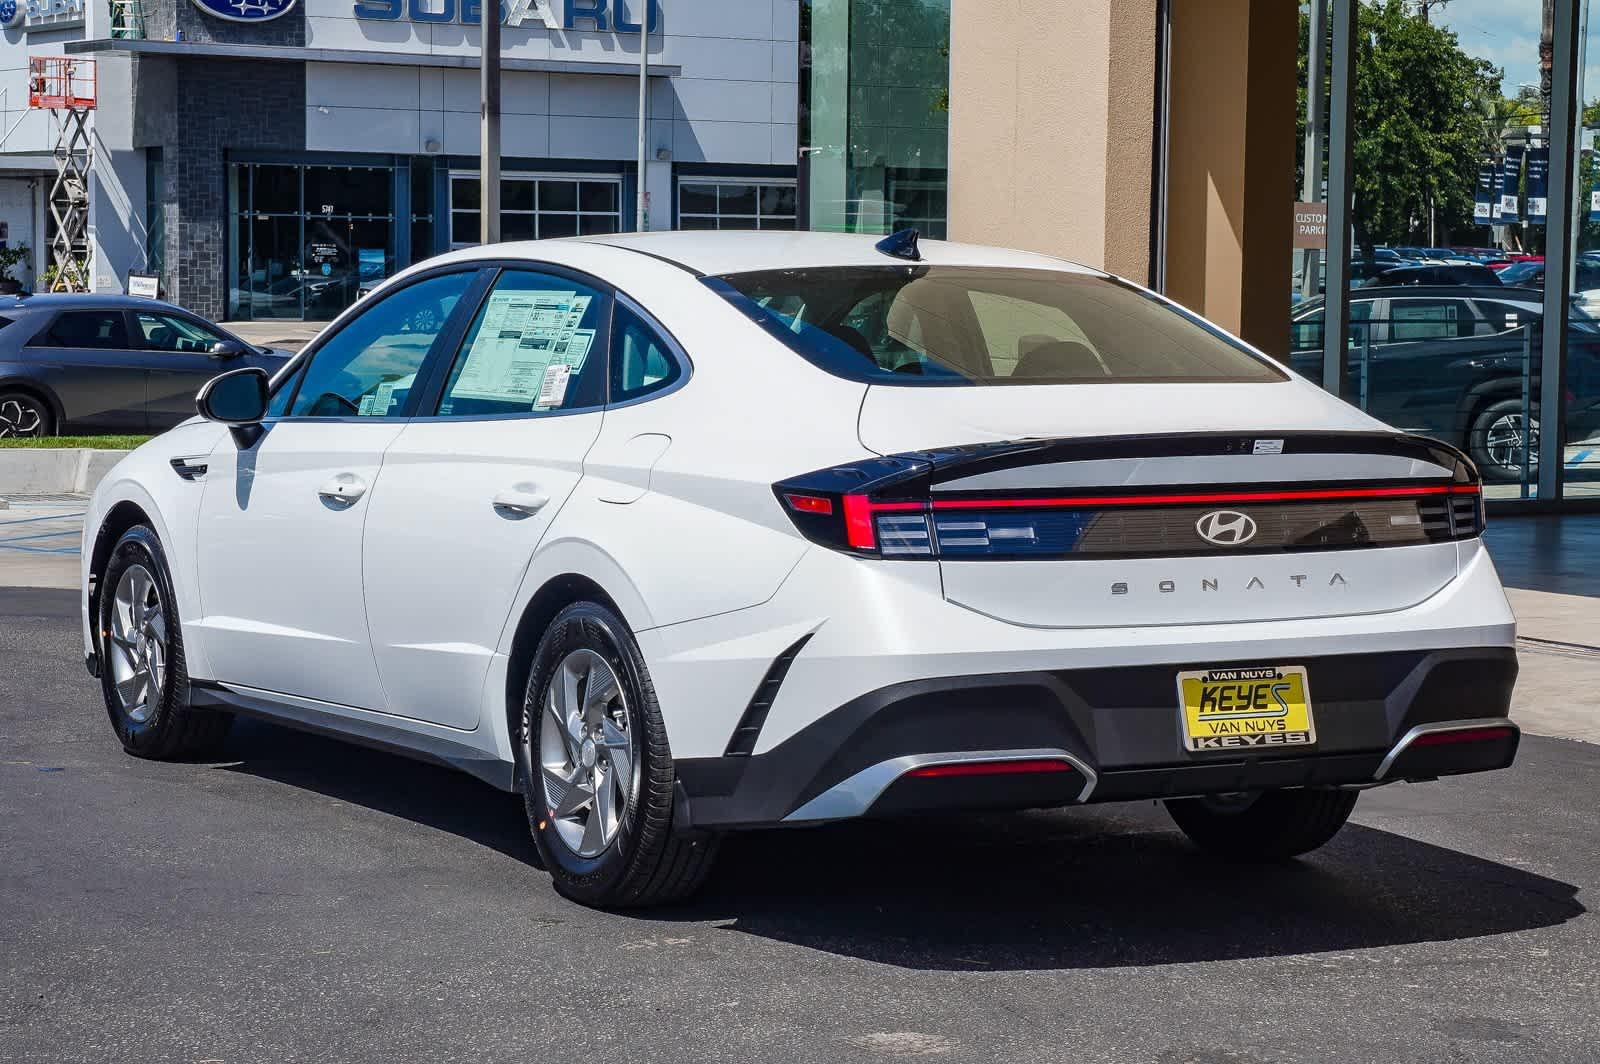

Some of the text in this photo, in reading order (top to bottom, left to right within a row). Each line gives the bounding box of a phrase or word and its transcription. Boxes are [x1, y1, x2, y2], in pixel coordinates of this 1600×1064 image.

[1111, 572, 1347, 595] SONATA
[1212, 670, 1274, 681] VAN NUYS
[1199, 683, 1291, 718] KEYES
[1209, 719, 1286, 734] VAN NUYS
[1198, 733, 1306, 748] KEYES
